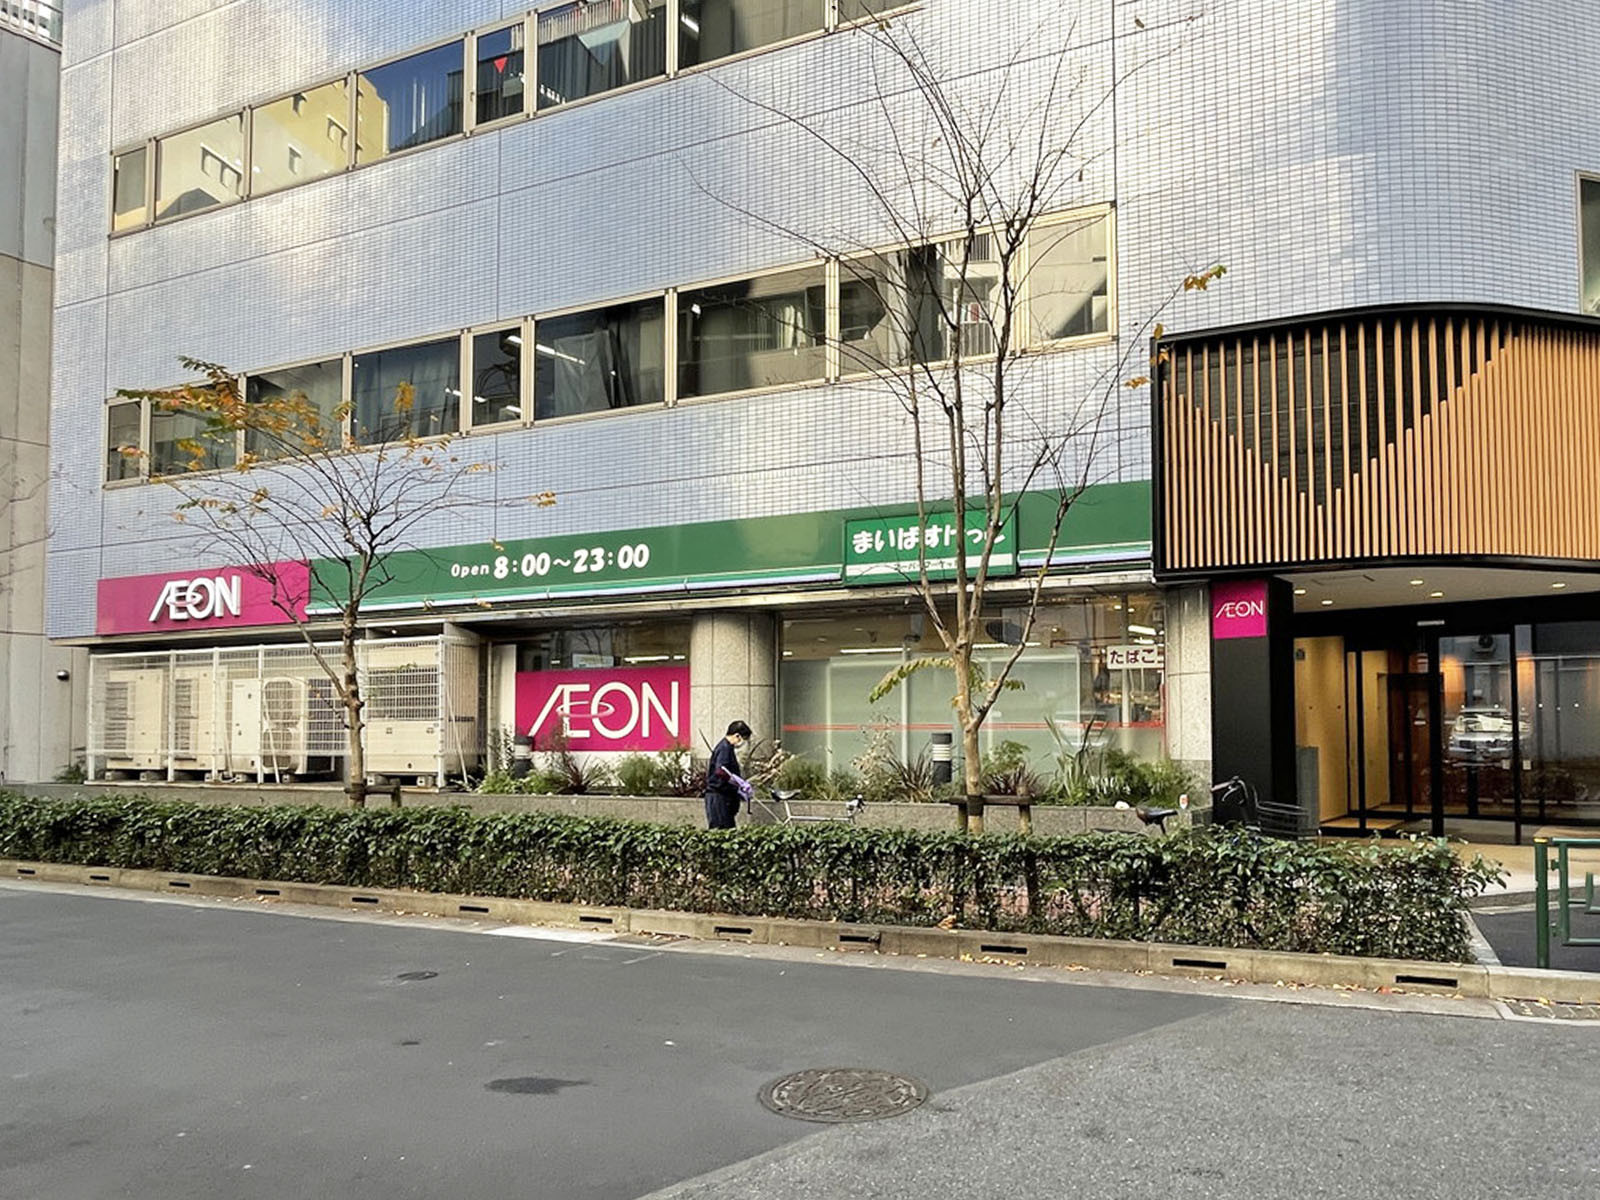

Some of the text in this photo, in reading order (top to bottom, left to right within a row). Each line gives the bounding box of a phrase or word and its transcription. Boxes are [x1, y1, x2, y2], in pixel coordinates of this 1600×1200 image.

[451, 563, 490, 578] Open
[1110, 648, 1155, 664] たばこ
